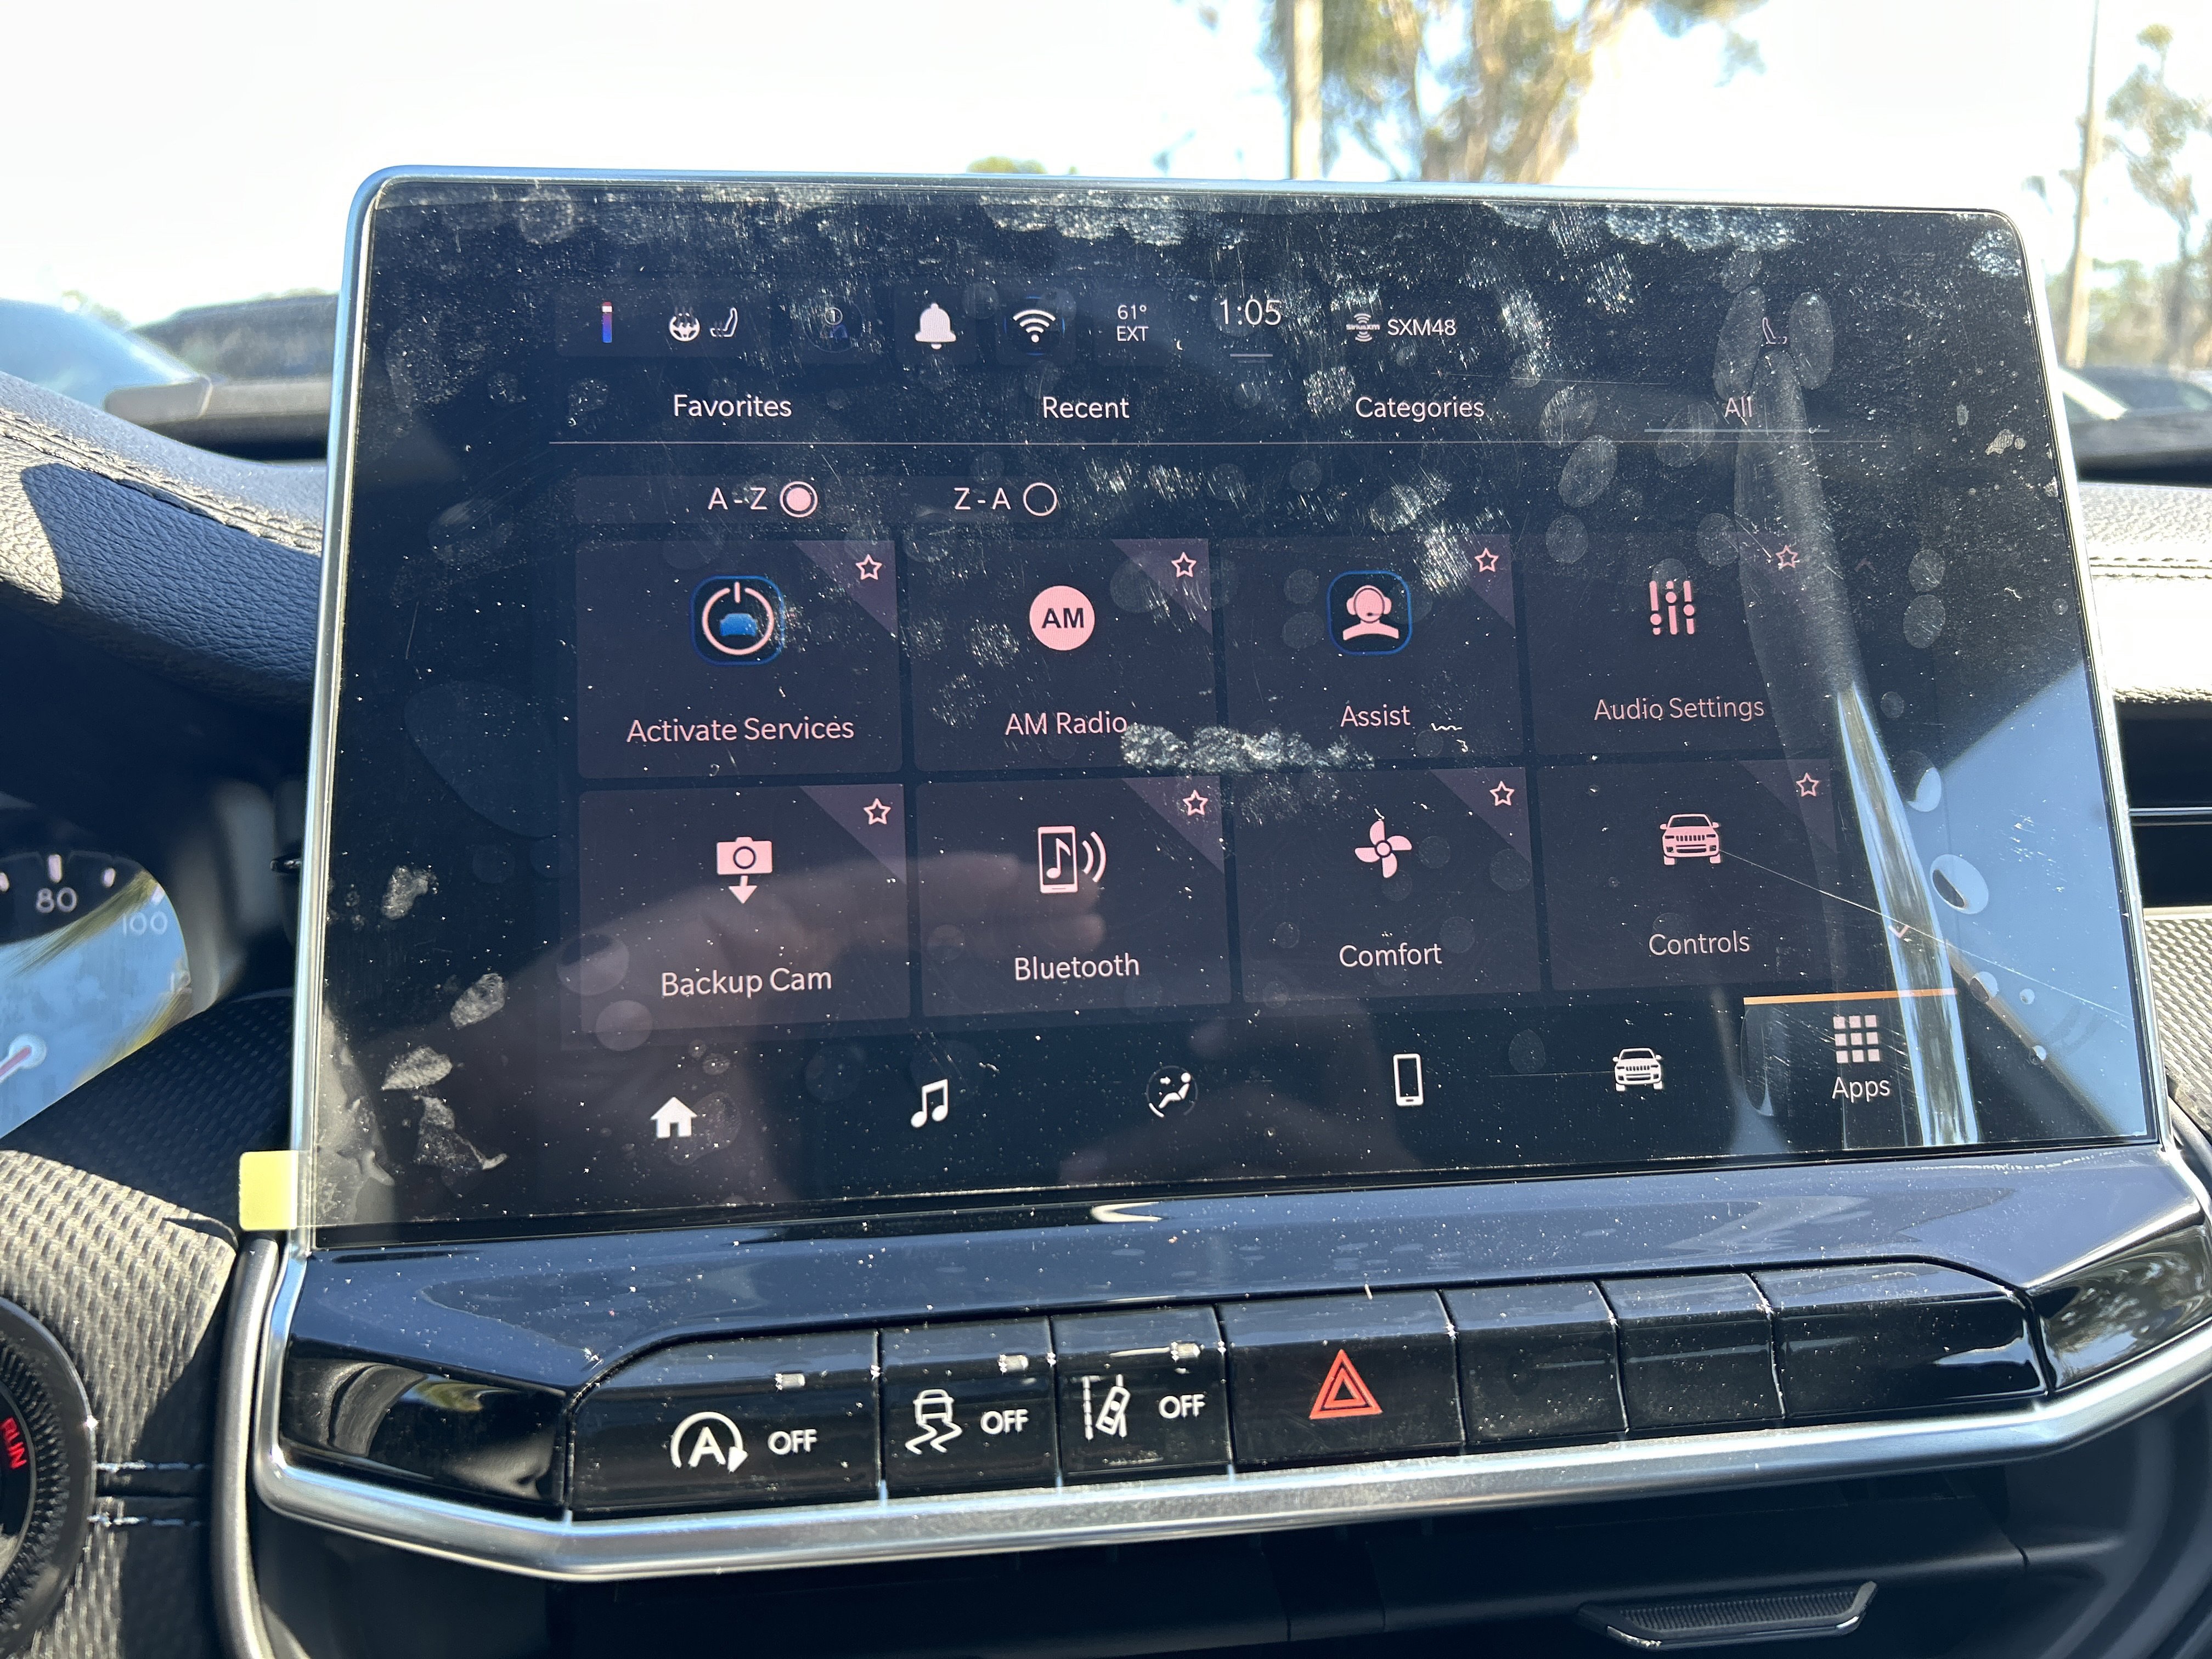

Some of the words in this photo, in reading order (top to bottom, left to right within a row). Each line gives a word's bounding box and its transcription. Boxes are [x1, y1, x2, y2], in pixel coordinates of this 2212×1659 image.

[1118, 304, 1148, 320] 61°
[1219, 300, 1282, 326] 1:05
[1116, 326, 1149, 342] EXT
[1387, 319, 1457, 336] SXM48
[673, 394, 792, 417] Favorites
[1042, 397, 1130, 419] Recent
[1355, 397, 1486, 424] Categories
[1724, 396, 1753, 419] All
[1041, 607, 1085, 629] AM
[1005, 713, 1047, 735] AM
[1057, 711, 1128, 735] Radio
[1340, 704, 1411, 727] Assist
[1594, 698, 1664, 721] Audio
[1668, 697, 1765, 723] Settings
[626, 718, 737, 743] Activate
[743, 716, 855, 741] Services
[36, 887, 78, 913] 80
[122, 911, 167, 936] 100
[1339, 941, 1443, 968] Comfort
[1649, 930, 1751, 956] Controls
[1014, 953, 1140, 981] Bluetooth
[661, 972, 764, 998] Backup
[769, 968, 833, 992] Cam
[1832, 1077, 1891, 1103] Apps
[1158, 1393, 1205, 1419] OFF
[980, 1408, 1029, 1435] OFF
[768, 1428, 818, 1455] OFF
